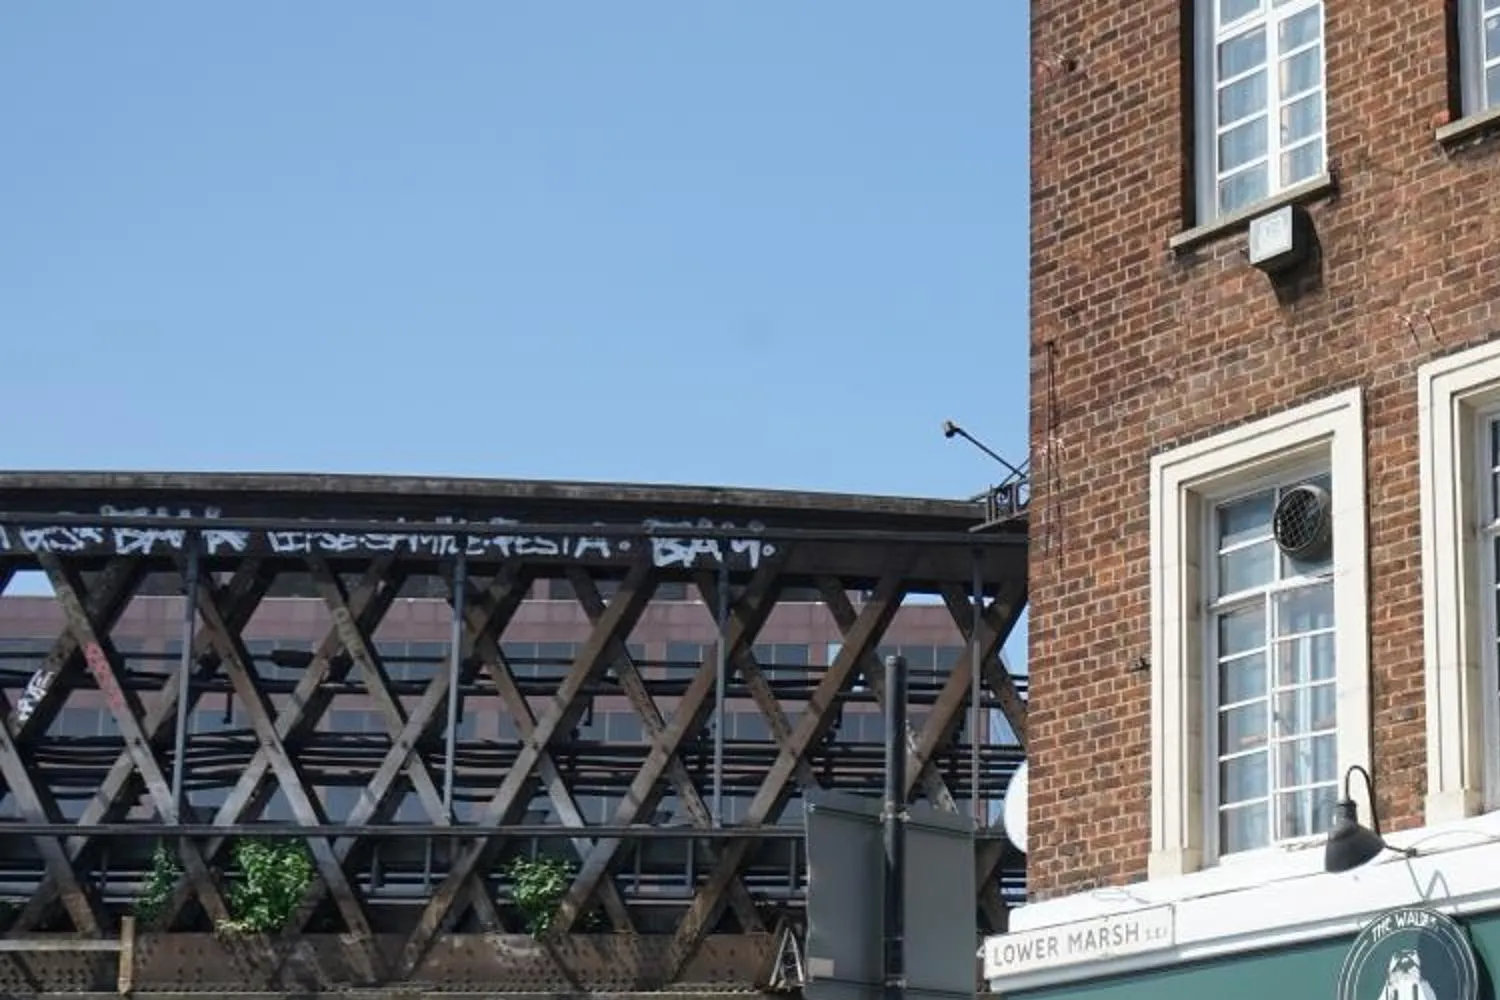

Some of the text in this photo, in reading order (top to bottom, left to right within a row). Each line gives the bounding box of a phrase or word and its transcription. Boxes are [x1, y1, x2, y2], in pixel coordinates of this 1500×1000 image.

[993, 936, 1059, 966] LOWER
[1067, 921, 1139, 953] MARSH
[1372, 915, 1392, 942] THE
